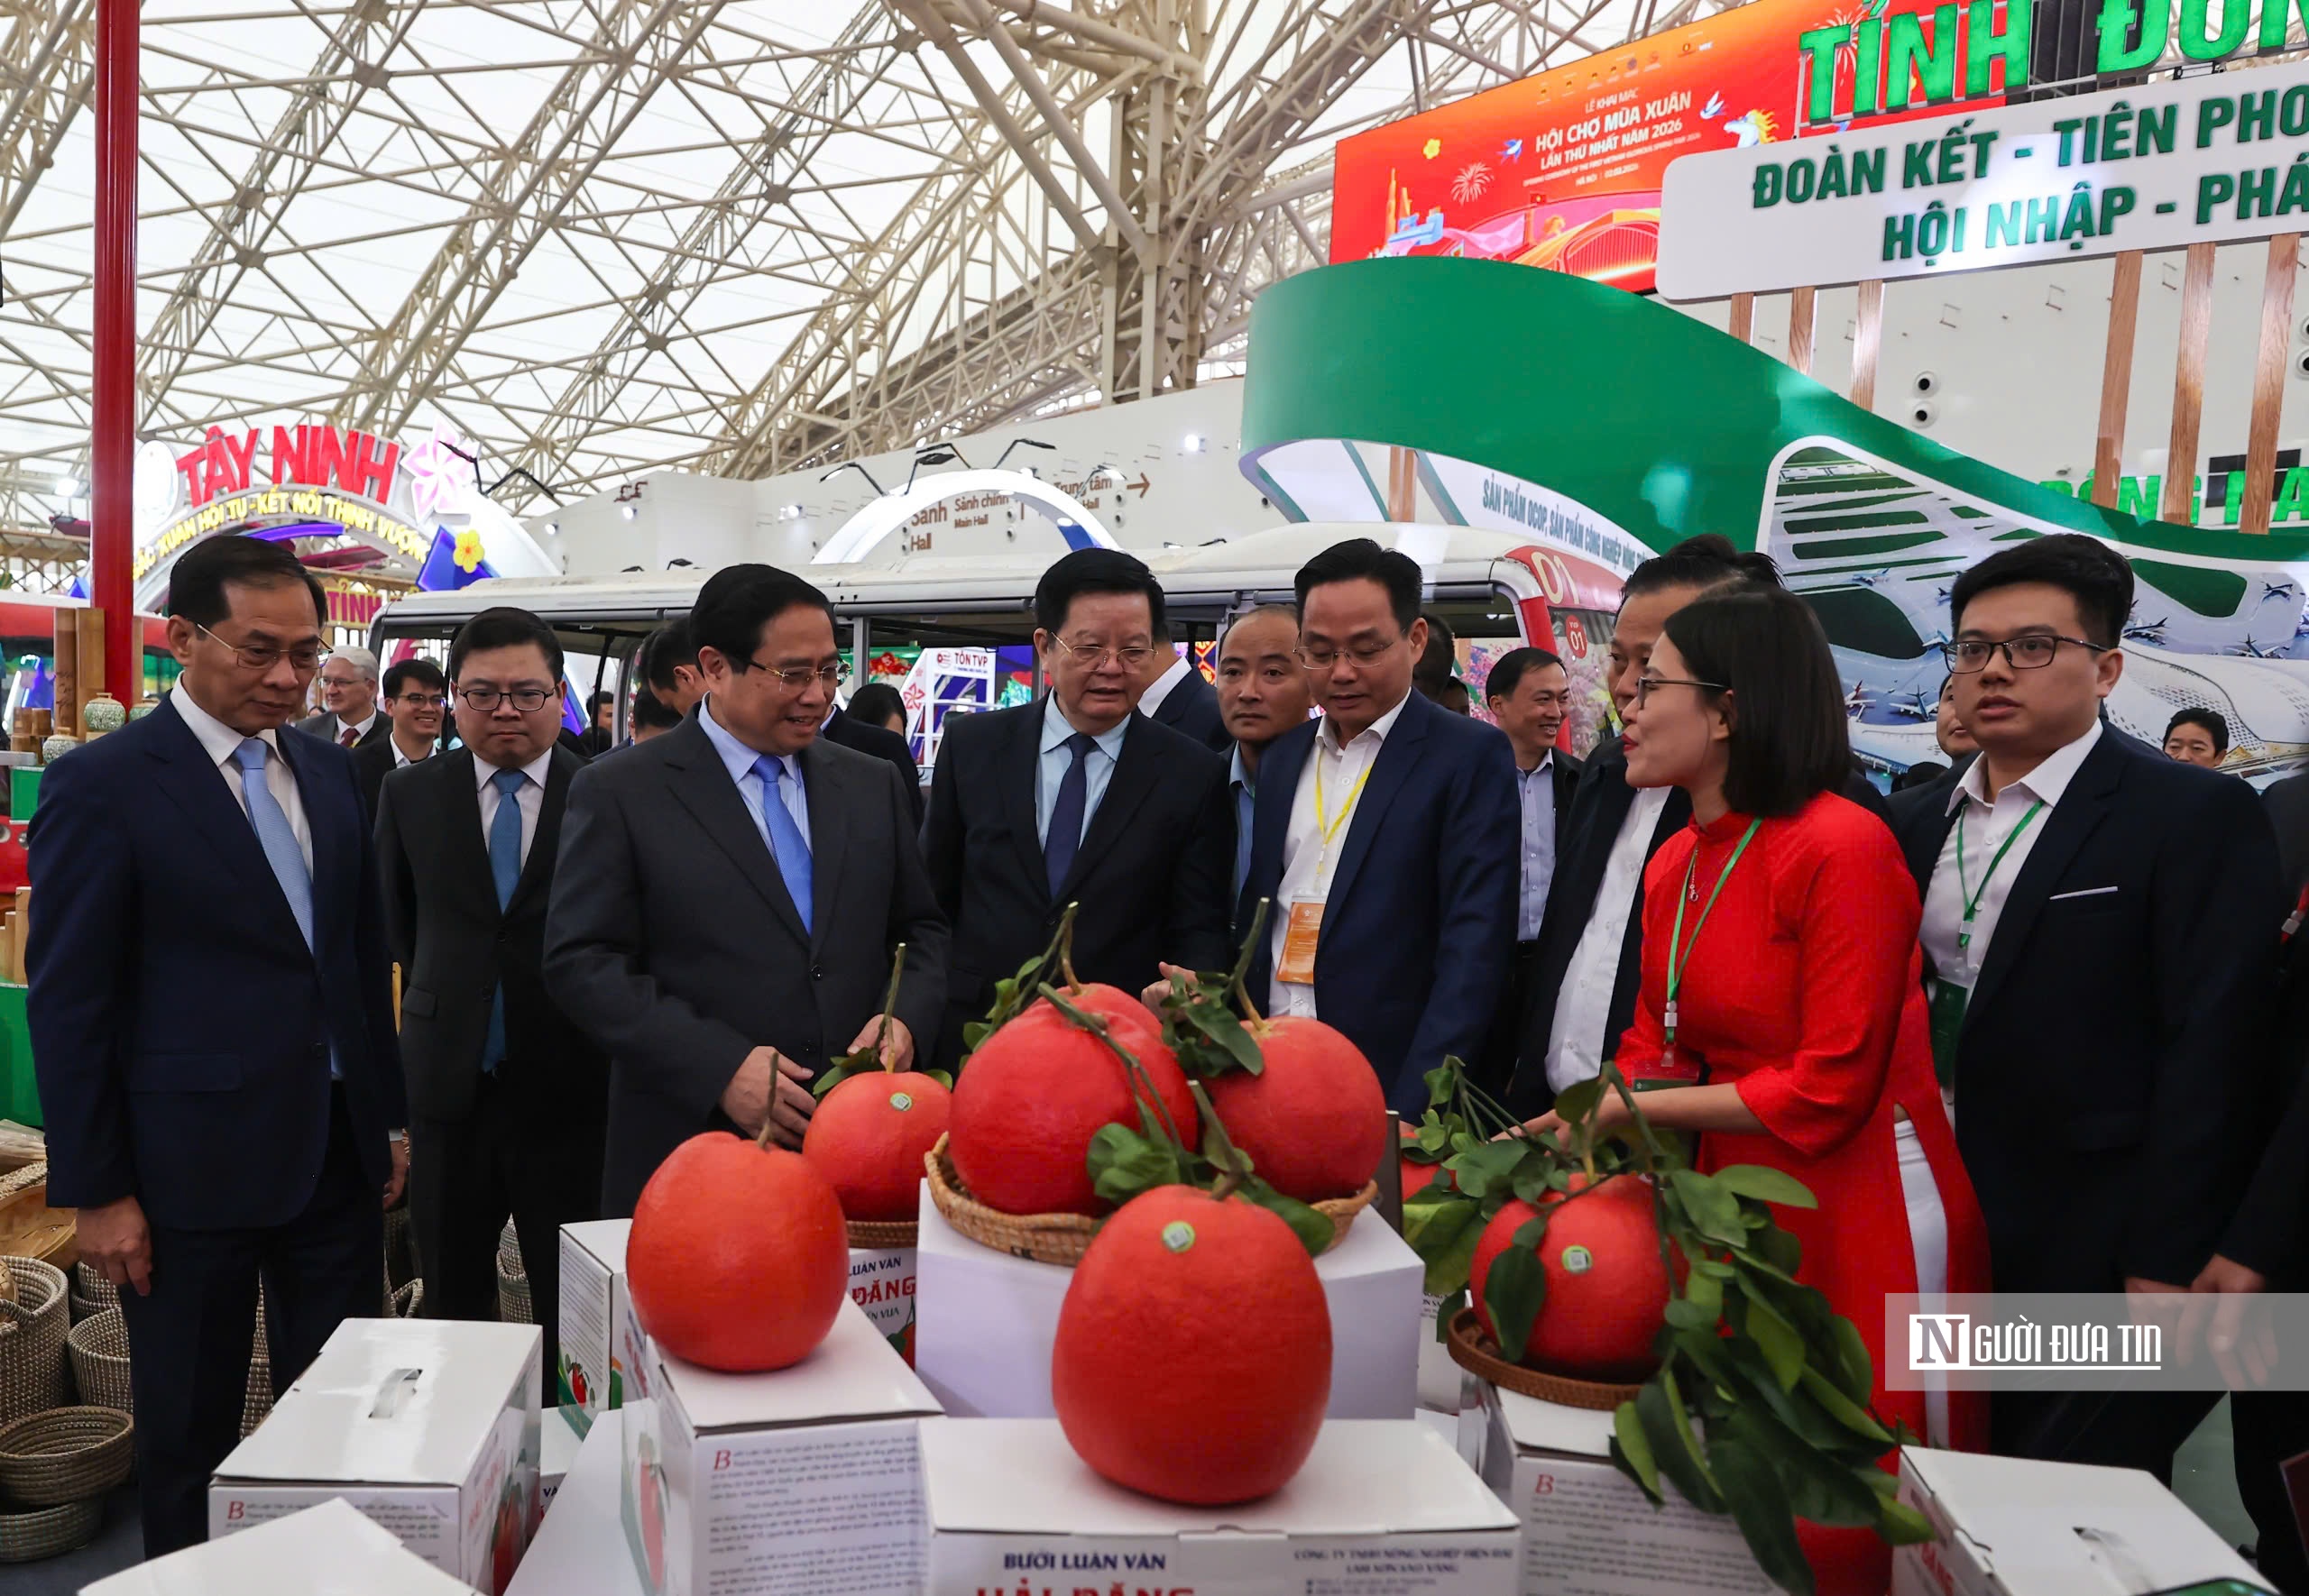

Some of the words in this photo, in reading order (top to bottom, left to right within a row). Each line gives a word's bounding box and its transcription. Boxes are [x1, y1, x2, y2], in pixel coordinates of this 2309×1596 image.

[1535, 128, 1562, 152] HỘI
[1567, 114, 1600, 140] CHỢ
[1605, 102, 1641, 133] MÙA
[1645, 90, 1692, 121] XUÂN
[1541, 150, 1561, 170] LẦN
[1589, 133, 1620, 156] NHẤT
[1622, 126, 1650, 146] NĂM
[1652, 118, 1683, 139] 2026
[1753, 144, 1886, 208] ĐOÀN
[1902, 118, 1999, 188] KẾT
[2053, 101, 2179, 168] TIÊN
[1882, 200, 1967, 266] HỘI
[1985, 180, 2137, 250] NHẬP
[175, 425, 260, 509] TÂY
[272, 425, 400, 505] NINH
[1090, 475, 1113, 491] tâm
[198, 502, 225, 533] HỘI
[225, 497, 247, 524] TỤ
[256, 484, 290, 515] KẾT
[292, 487, 322, 516] NỐI
[325, 495, 375, 532] THỊNH
[954, 518, 973, 529] Main
[973, 513, 989, 526] Hall
[1483, 472, 1502, 515] SẢN
[1503, 482, 1526, 525] PHẨM
[910, 532, 933, 552] Hall
[1531, 551, 1580, 605] 01
[973, 655, 989, 667] TVP
[1570, 630, 1585, 650] 01
[850, 1261, 877, 1277] UẬN
[1003, 1551, 1056, 1571] BƯỞI
